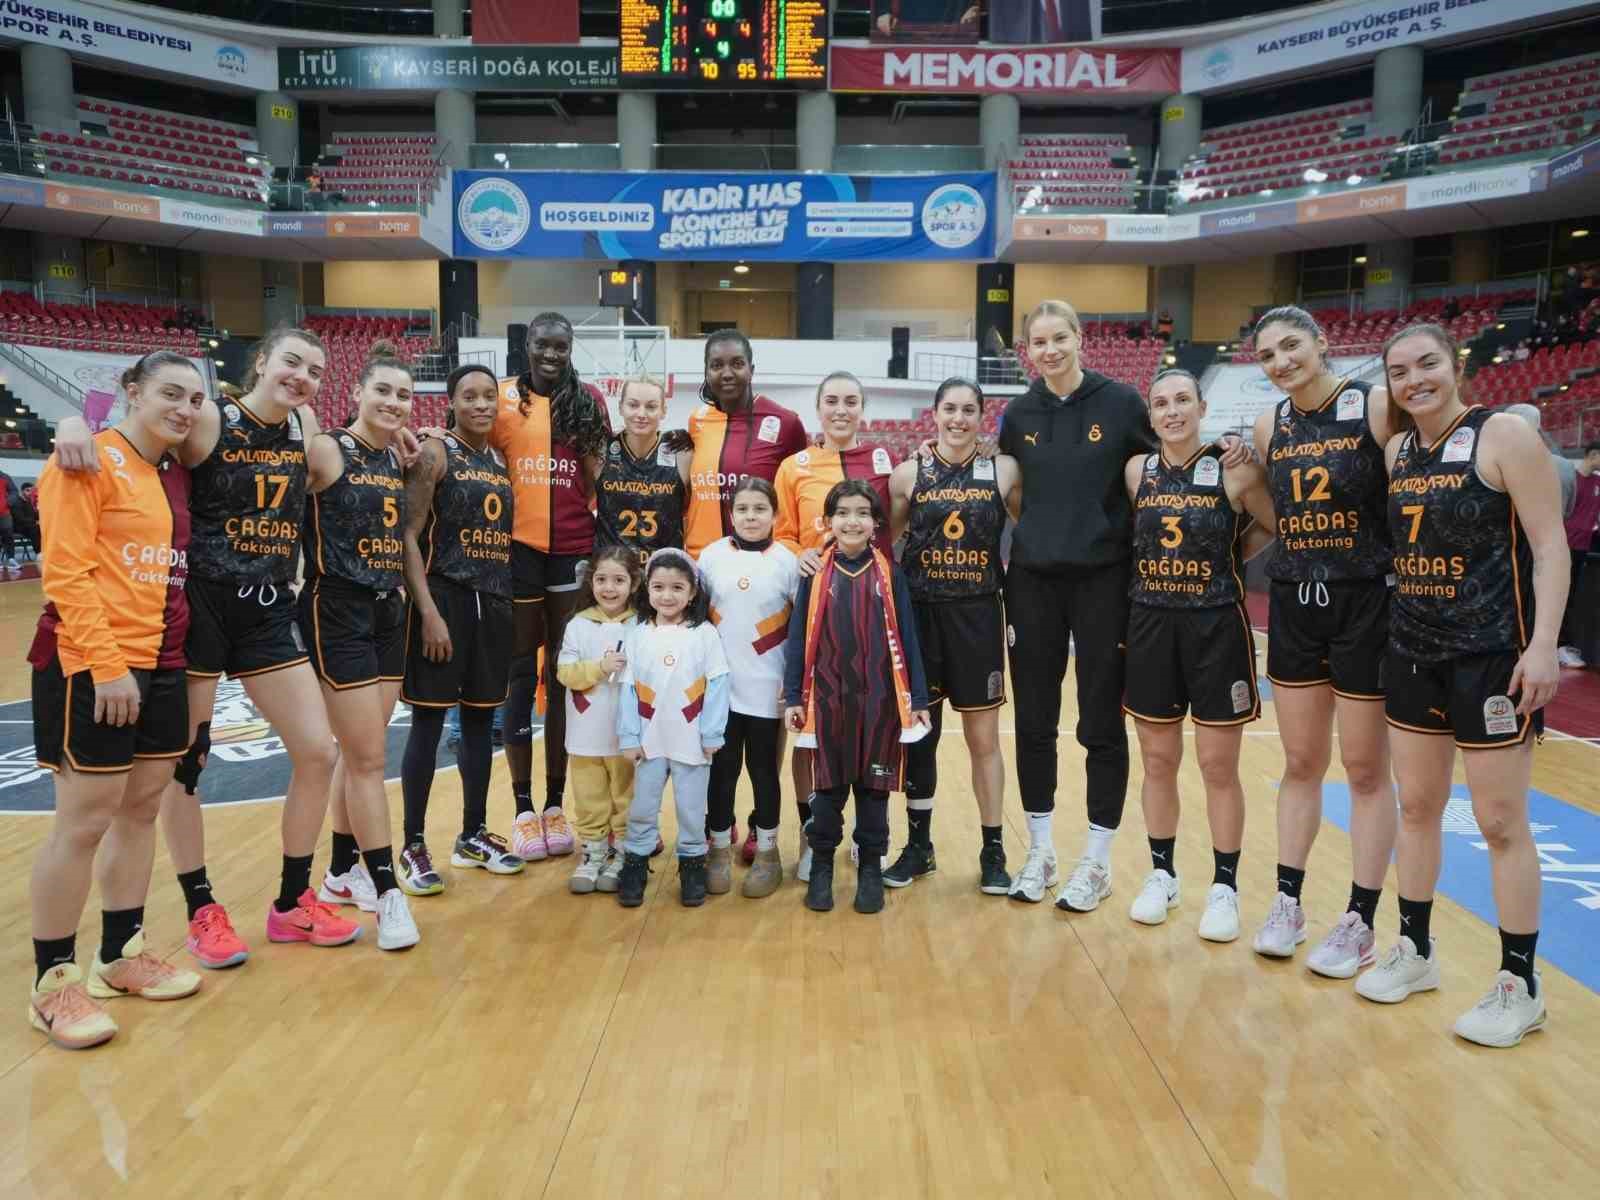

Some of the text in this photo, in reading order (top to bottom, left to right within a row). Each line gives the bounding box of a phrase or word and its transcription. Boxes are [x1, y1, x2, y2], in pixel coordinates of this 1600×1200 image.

[0, 15, 48, 36] POR
[1345, 27, 1399, 49] SPOR
[299, 49, 336, 75] İTÜ
[393, 57, 478, 76] KAYSERİ
[484, 56, 541, 76] DOĞA
[547, 57, 618, 77] KOLEJİ
[737, 63, 757, 79] 95
[883, 51, 1130, 89] MEMORIAL
[662, 181, 803, 213] KADİR HAS
[544, 209, 650, 225] HOŞGELDİNİZ
[671, 209, 757, 233] KONGRE
[761, 209, 788, 228] VE
[1219, 213, 1256, 227] mondi
[659, 224, 785, 249] SPOR MERKEZİ
[1271, 436, 1361, 460] GALATASARAY
[516, 454, 577, 477] ÇAĞDAŞ
[255, 474, 289, 508] 17
[603, 480, 676, 495] GALATASARAY
[916, 488, 994, 502] GALATASARAY
[1290, 466, 1331, 503] 12
[383, 496, 399, 528] 5
[484, 493, 502, 520] 0
[1137, 494, 1220, 509] GALATASARAY
[225, 516, 298, 543] ÇAĞDAŞ
[618, 510, 657, 537] 23
[943, 510, 965, 540] 6
[1160, 516, 1183, 548] 3
[1279, 511, 1358, 538] ÇAĞDAŞ
[1401, 505, 1424, 543] 7
[1286, 535, 1353, 551] faktoring
[921, 546, 988, 569] ÇAĞDAŞ
[1138, 556, 1212, 580] ÇAĞDAŞ
[928, 567, 982, 583] faktoring
[1145, 579, 1205, 595] faktoring
